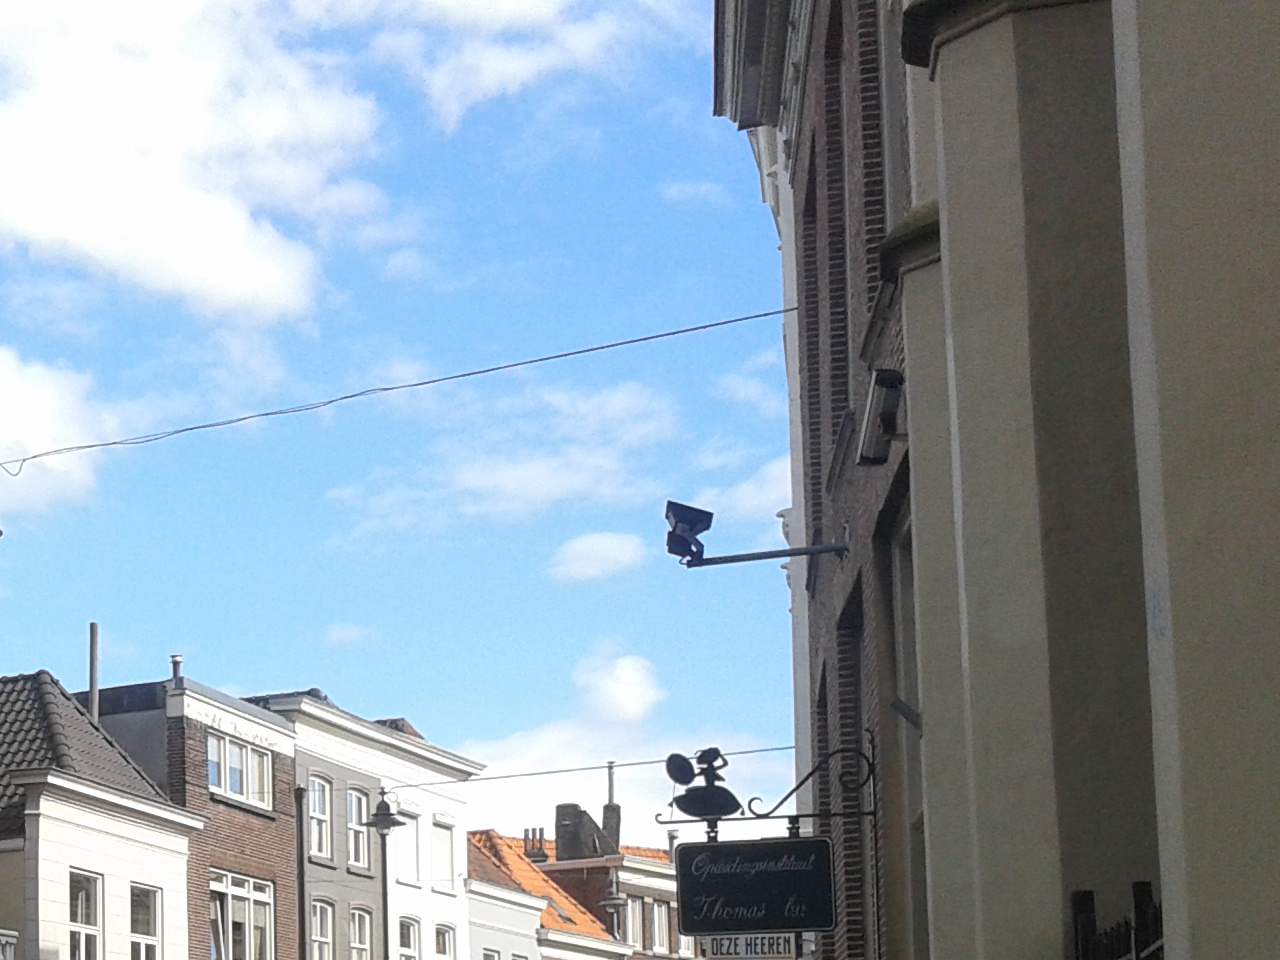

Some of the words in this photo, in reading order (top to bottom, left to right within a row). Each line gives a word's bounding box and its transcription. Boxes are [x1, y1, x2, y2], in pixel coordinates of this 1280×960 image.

[694, 895, 766, 920] Thomas
[710, 936, 741, 956] DEZE
[744, 935, 792, 956] HEEREN
